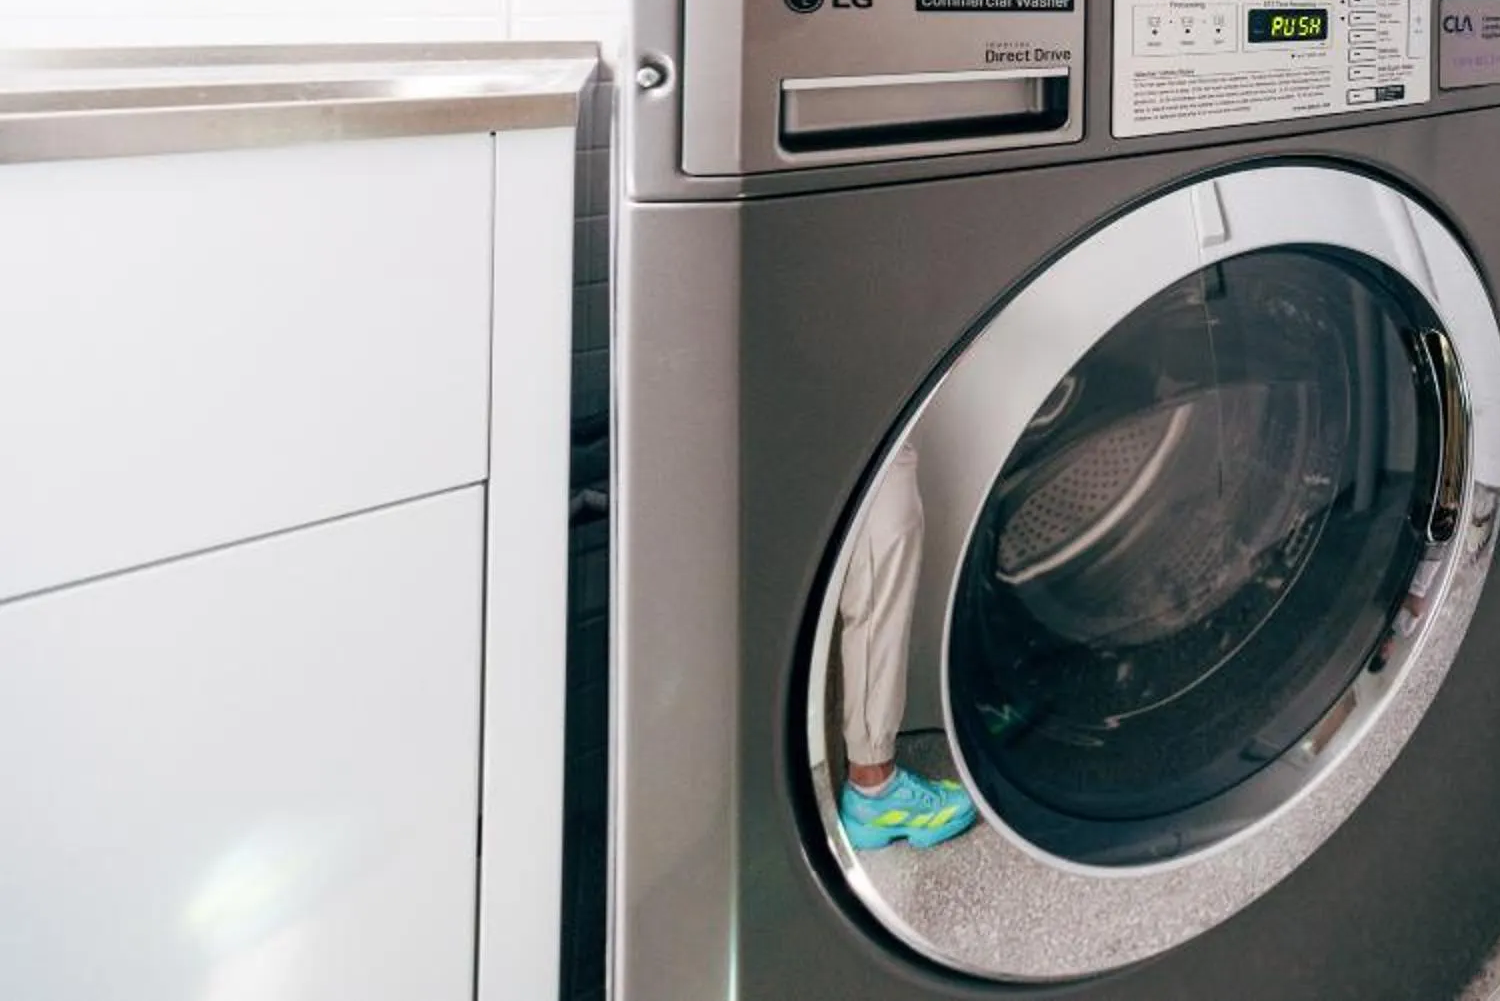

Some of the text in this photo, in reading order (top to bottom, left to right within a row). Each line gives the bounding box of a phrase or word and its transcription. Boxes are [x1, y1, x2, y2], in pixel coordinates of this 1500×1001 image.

[1271, 16, 1321, 37] PUSH
[1443, 14, 1473, 33] CLA
[985, 48, 1071, 63] Direct Drive
